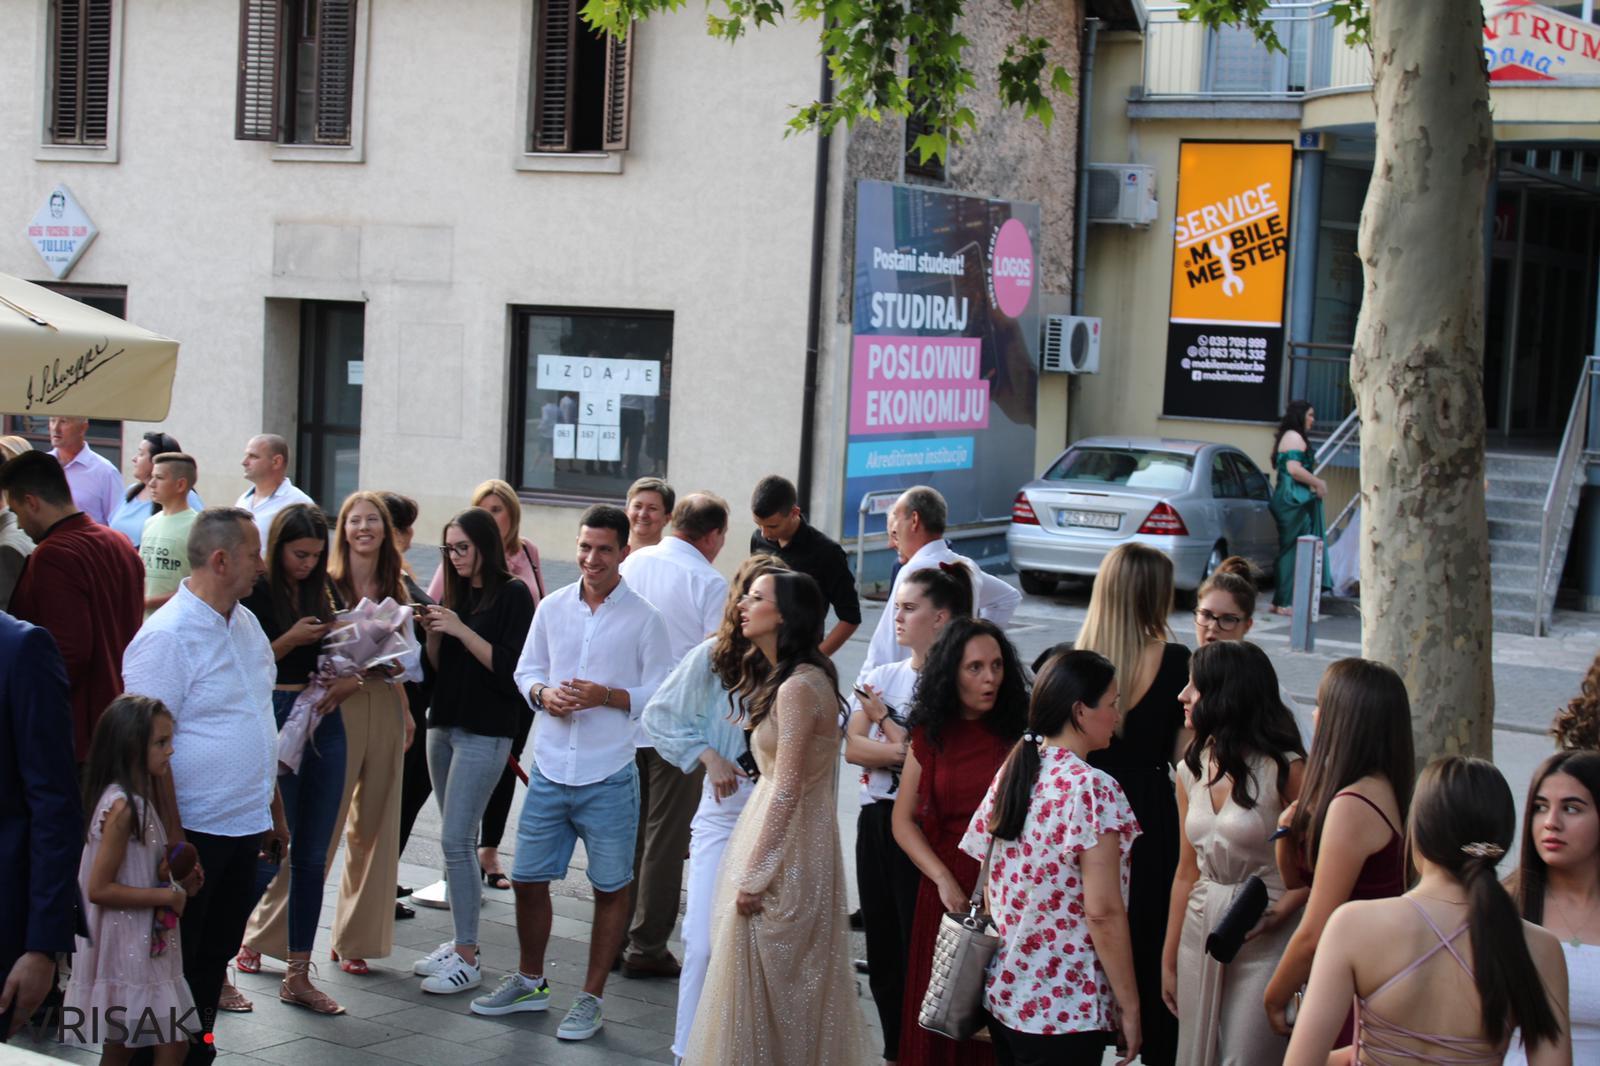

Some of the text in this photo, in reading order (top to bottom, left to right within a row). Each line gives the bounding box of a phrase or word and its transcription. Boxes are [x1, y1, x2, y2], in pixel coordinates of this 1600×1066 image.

[1171, 182, 1277, 241] SERVICE
[873, 247, 965, 276] Postani student!
[995, 256, 1031, 278] LOGOS
[870, 292, 969, 331] STUDIRAJ
[867, 344, 977, 380] POSLOVNU
[586, 399, 613, 416] SE
[865, 388, 985, 427] EKONOMIJU
[865, 445, 968, 469] Akreditirana institucija
[156, 547, 169, 557] GO
[156, 557, 182, 571] TRIP
